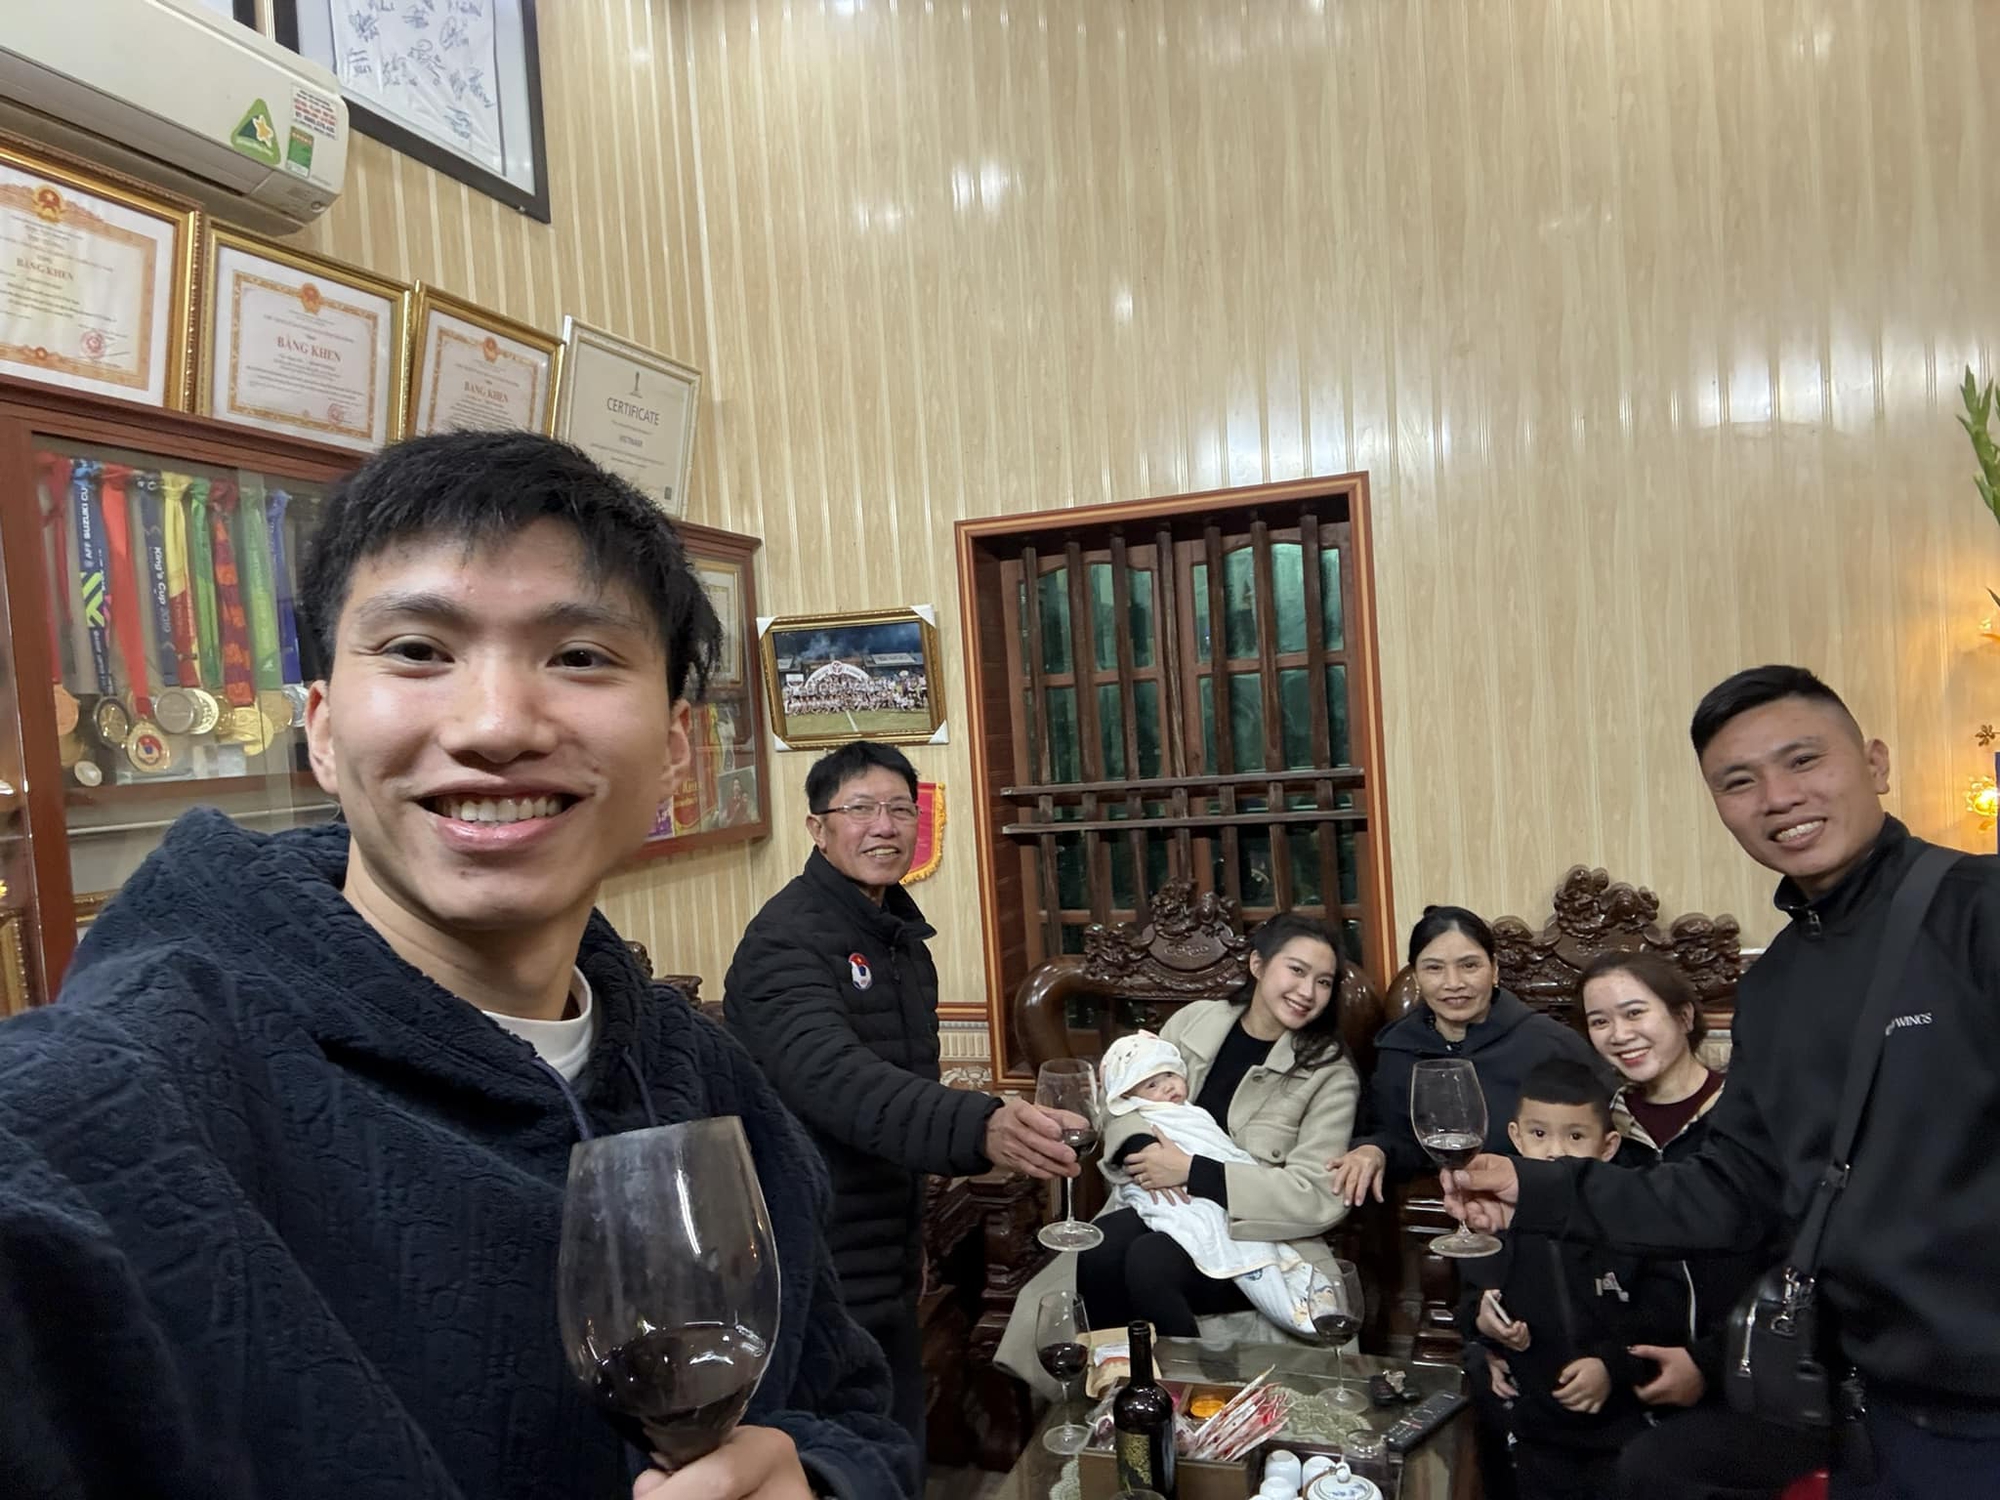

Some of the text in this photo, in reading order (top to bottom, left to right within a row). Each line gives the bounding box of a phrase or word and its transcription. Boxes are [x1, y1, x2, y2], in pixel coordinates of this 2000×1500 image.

[311, 345, 341, 362] KHEN
[607, 397, 660, 426] CERTIFICATE
[81, 487, 93, 559] AFF SUZUKI CU
[154, 547, 165, 579] King's
[158, 582, 167, 605] Cup
